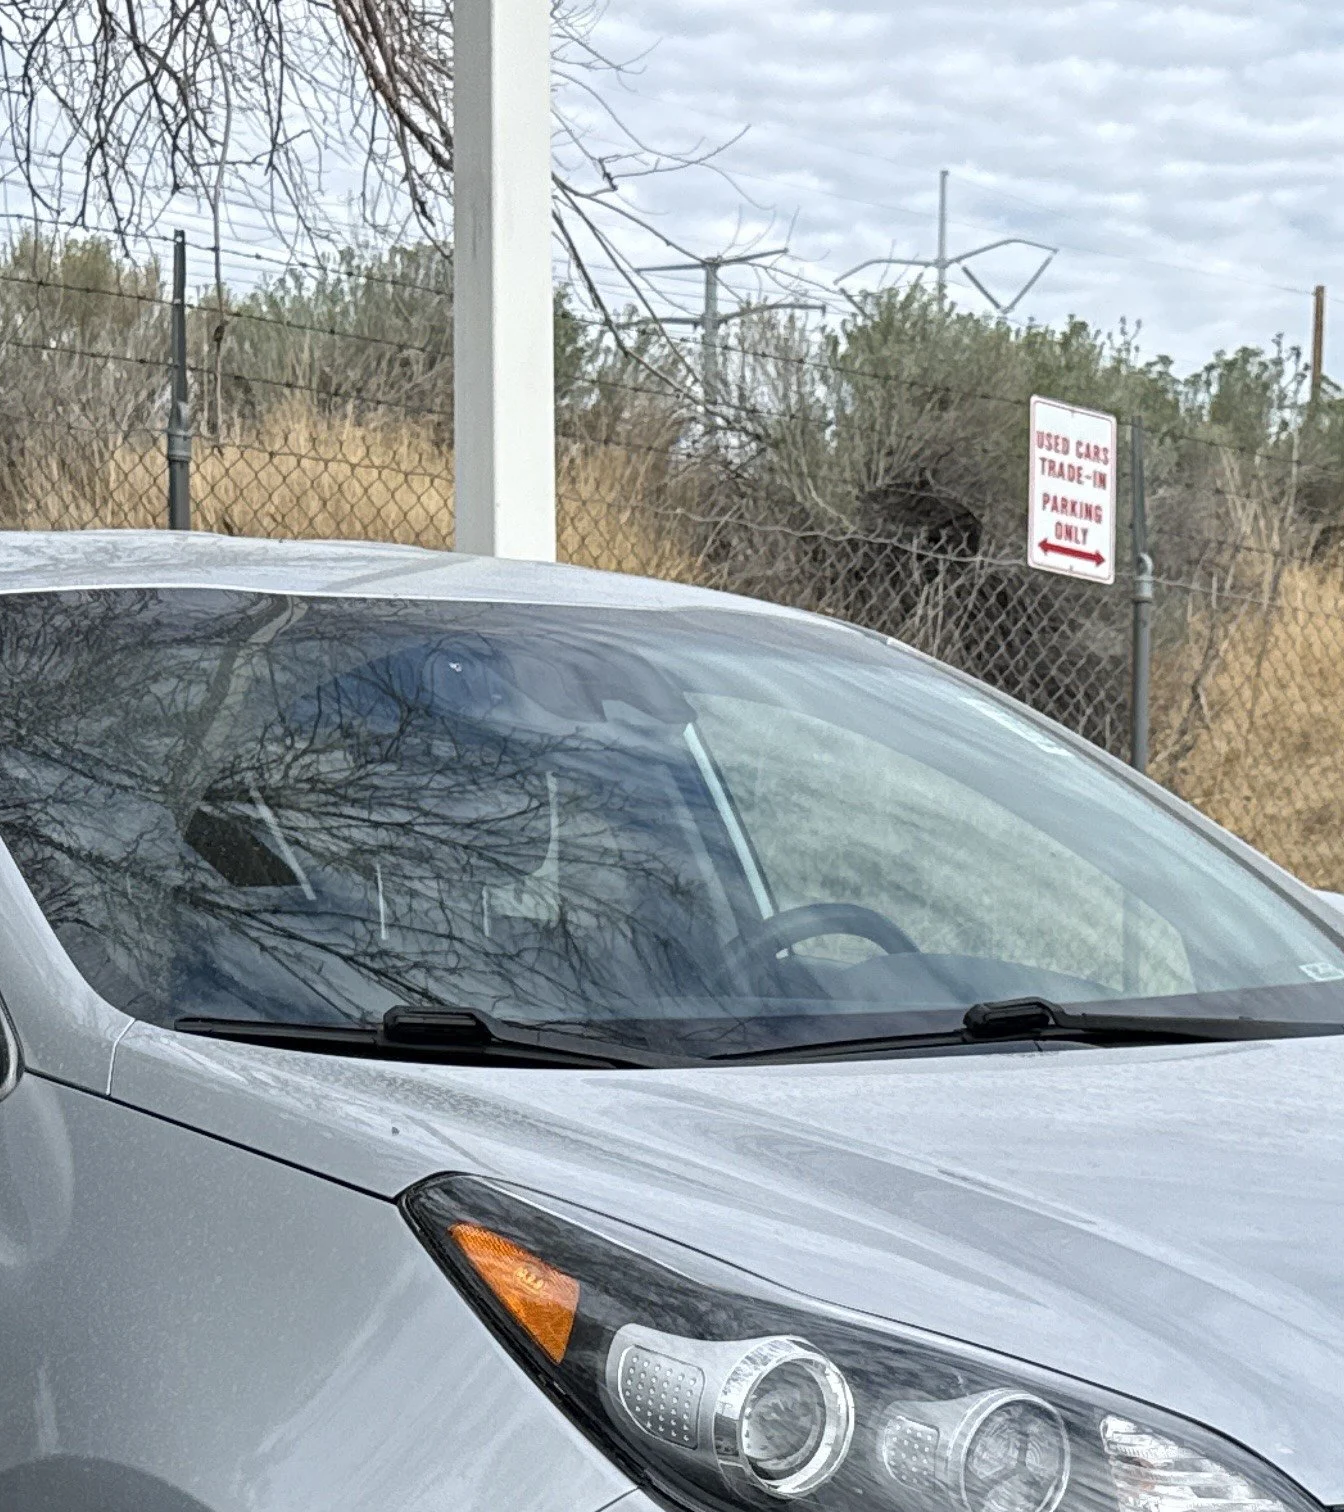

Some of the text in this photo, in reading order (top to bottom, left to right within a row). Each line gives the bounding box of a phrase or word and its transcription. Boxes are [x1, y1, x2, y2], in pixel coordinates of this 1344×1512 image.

[1036, 431, 1109, 465] USED CARS
[1039, 457, 1107, 490] TRADE-IN
[1042, 492, 1102, 524] PARKING
[1055, 522, 1088, 545] ONLY
